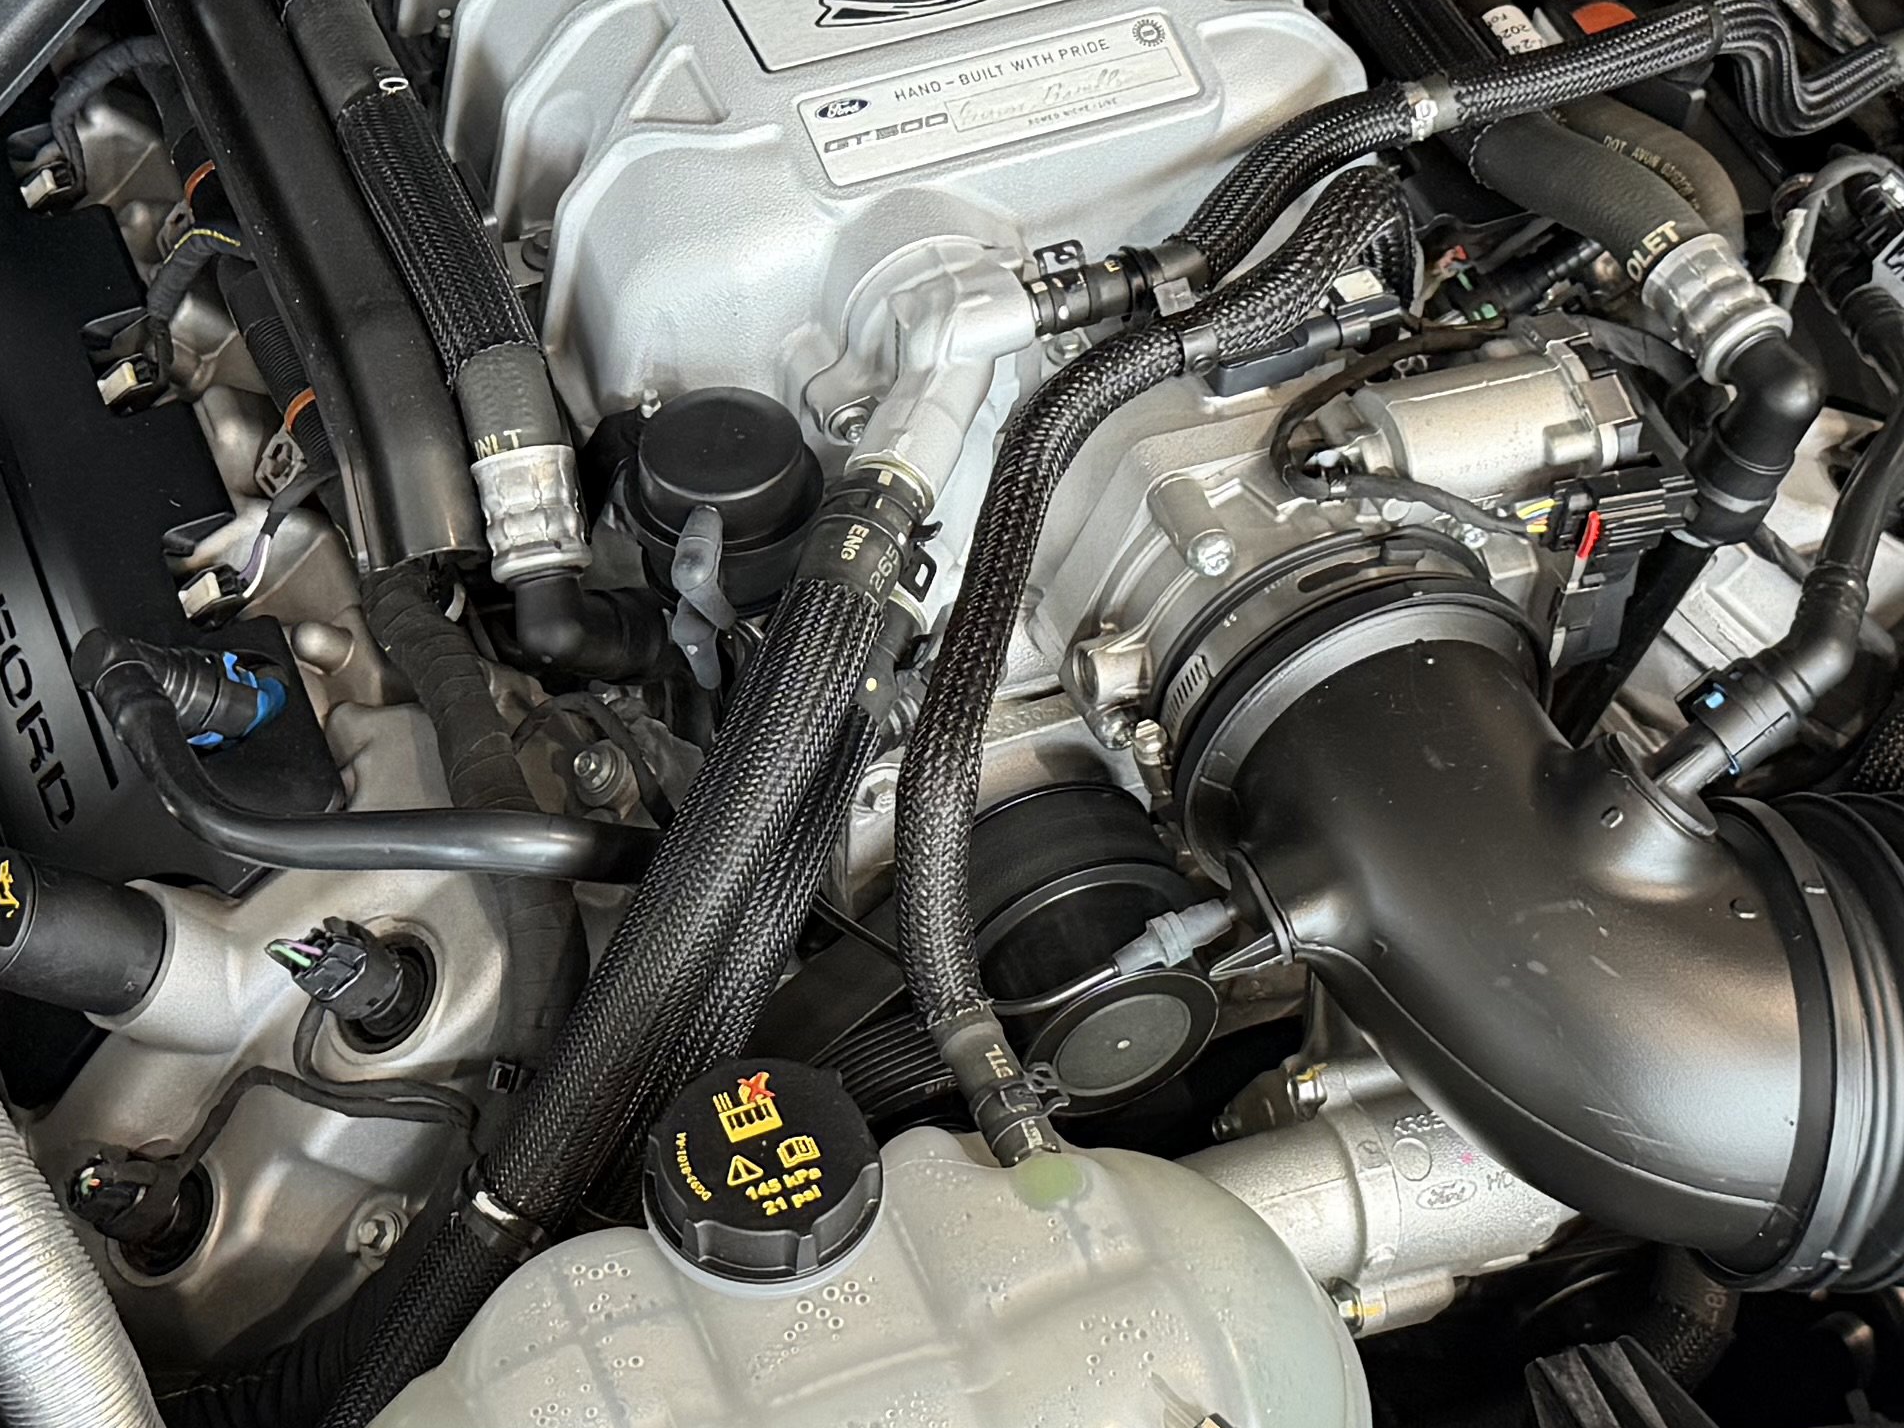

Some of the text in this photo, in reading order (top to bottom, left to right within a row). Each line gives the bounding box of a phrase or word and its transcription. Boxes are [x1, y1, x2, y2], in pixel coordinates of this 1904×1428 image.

[1011, 52, 1056, 73] WITH
[1059, 37, 1112, 62] PRIDE
[838, 524, 871, 563] ENG
[745, 1165, 823, 1201] 145 kPa
[762, 1198, 789, 1217] 21
